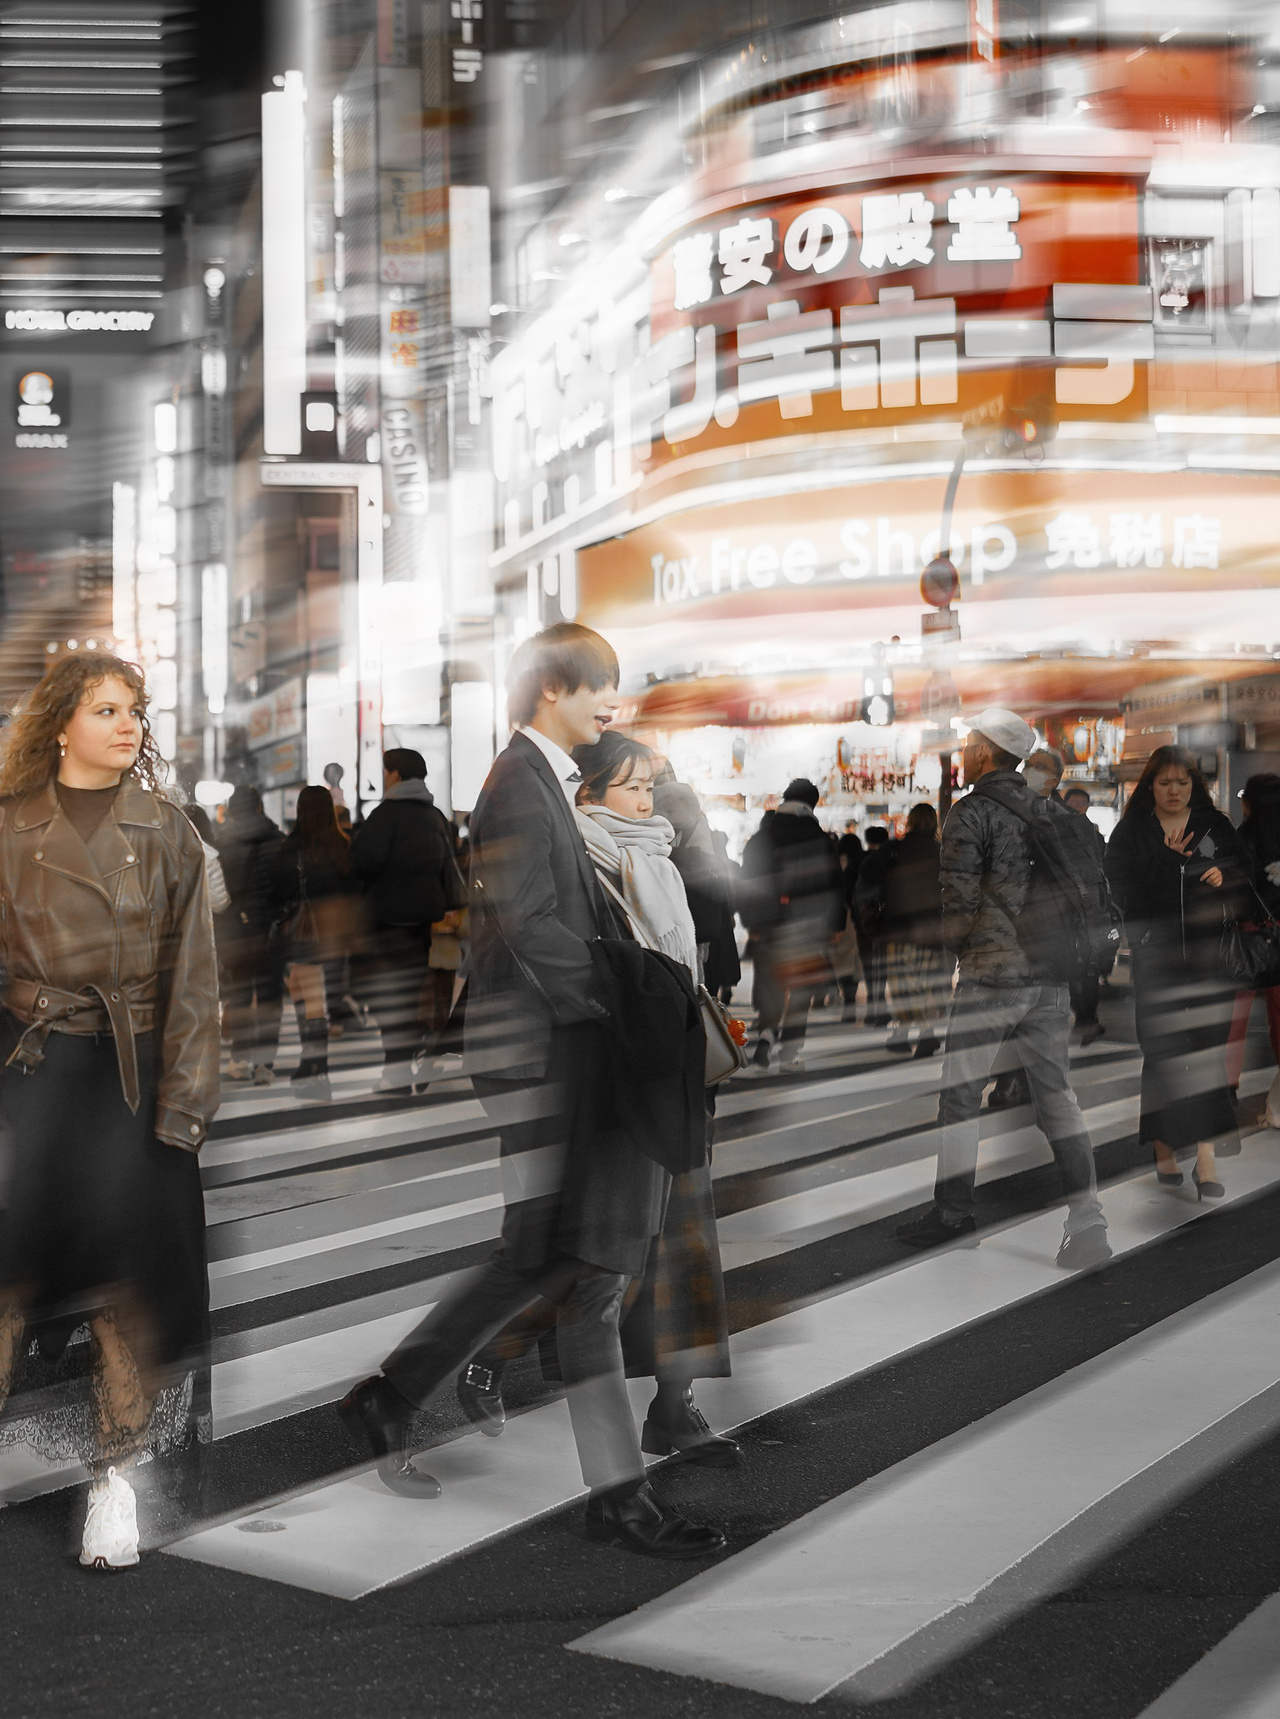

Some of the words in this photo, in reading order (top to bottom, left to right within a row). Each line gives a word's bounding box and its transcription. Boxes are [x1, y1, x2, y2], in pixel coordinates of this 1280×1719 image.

[384, 407, 425, 508] CASINO
[651, 552, 700, 607] Tax
[710, 537, 820, 595] Free
[838, 516, 1018, 586] Shop
[1044, 511, 1221, 570] 免税店
[747, 700, 798, 722] Don
